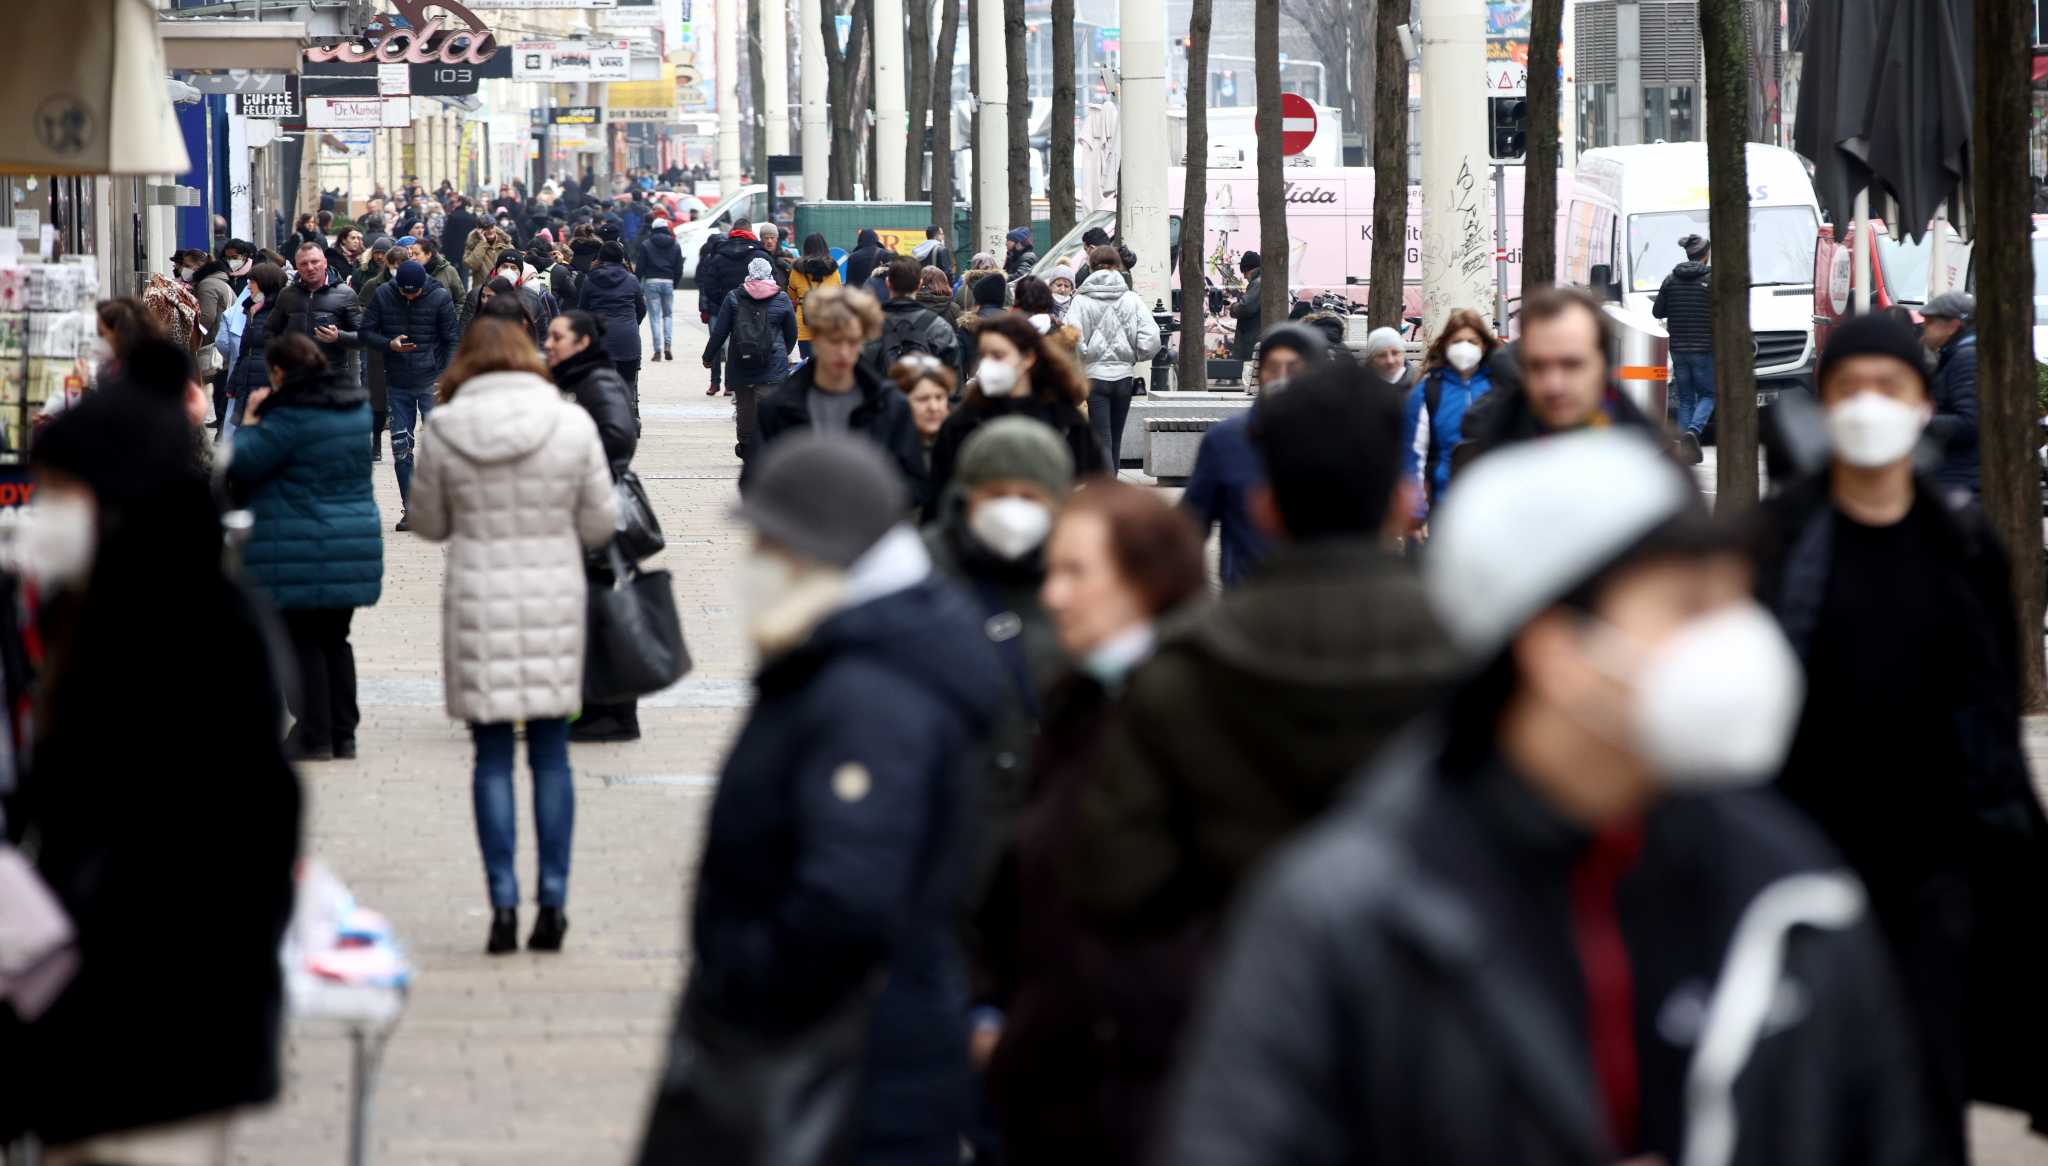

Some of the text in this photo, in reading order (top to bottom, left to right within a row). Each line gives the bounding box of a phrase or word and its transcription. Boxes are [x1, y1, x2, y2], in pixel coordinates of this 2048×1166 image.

[434, 69, 473, 83] 103
[242, 92, 293, 106] COFFEE
[242, 105, 293, 116] FELLOWS
[609, 111, 668, 119] DIE TASCHE
